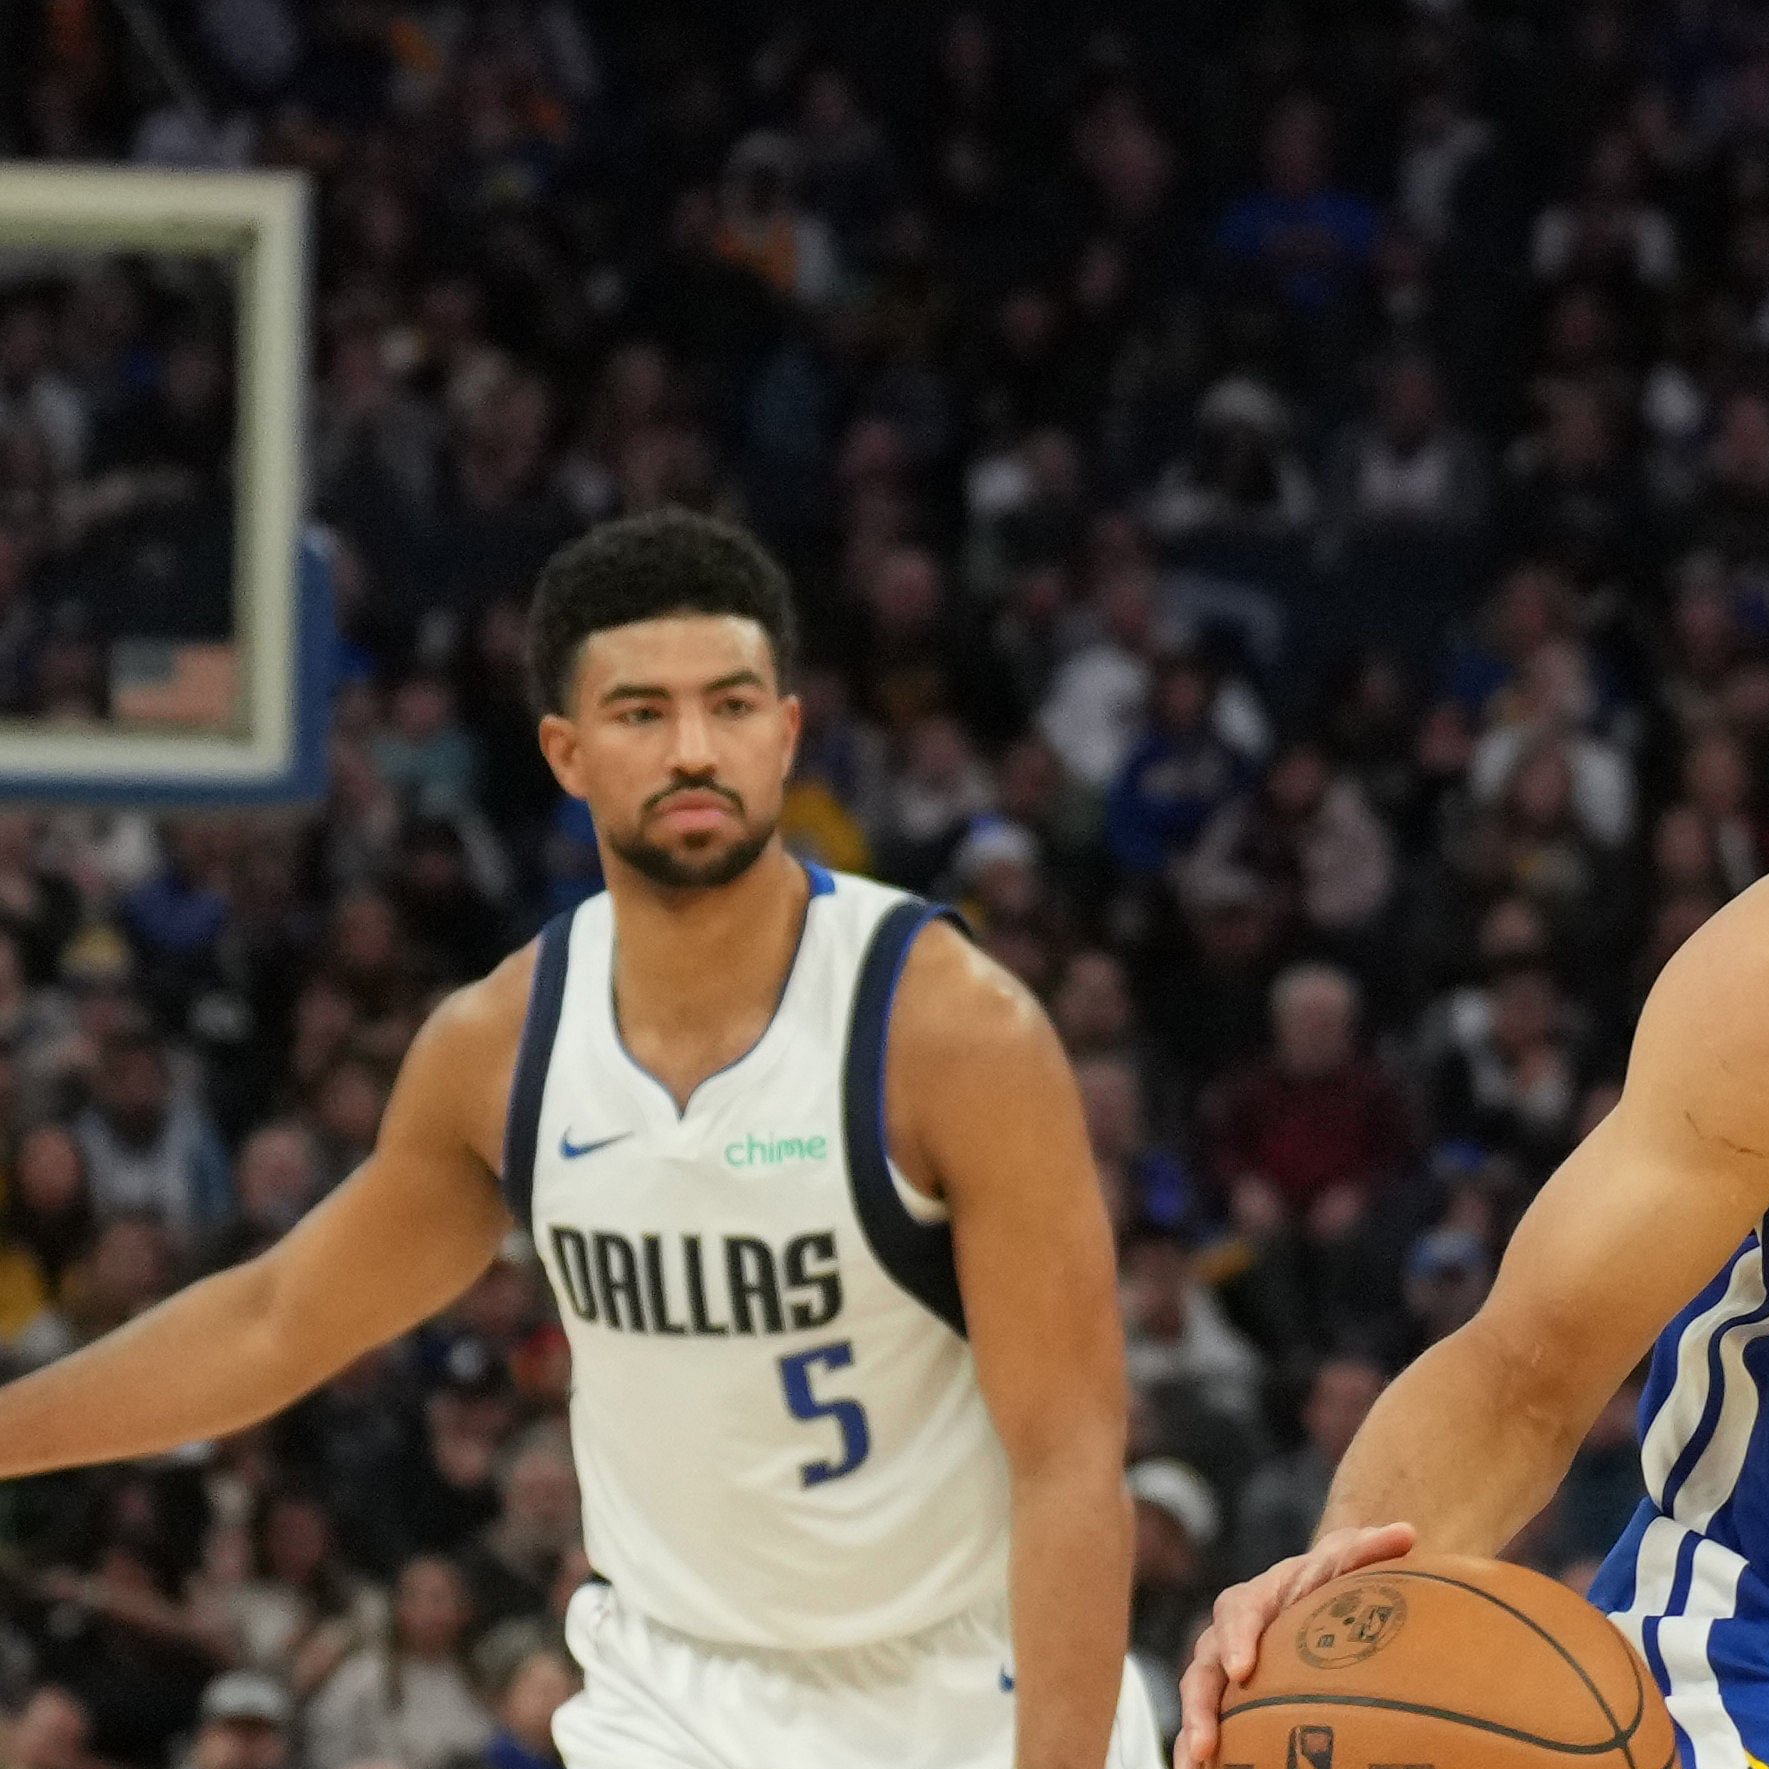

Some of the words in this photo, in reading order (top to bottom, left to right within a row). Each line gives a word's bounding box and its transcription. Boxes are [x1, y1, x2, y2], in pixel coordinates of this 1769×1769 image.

[723, 1130, 829, 1170] chime
[549, 1225, 846, 1339] DALLAS
[775, 1339, 872, 1490] 5
